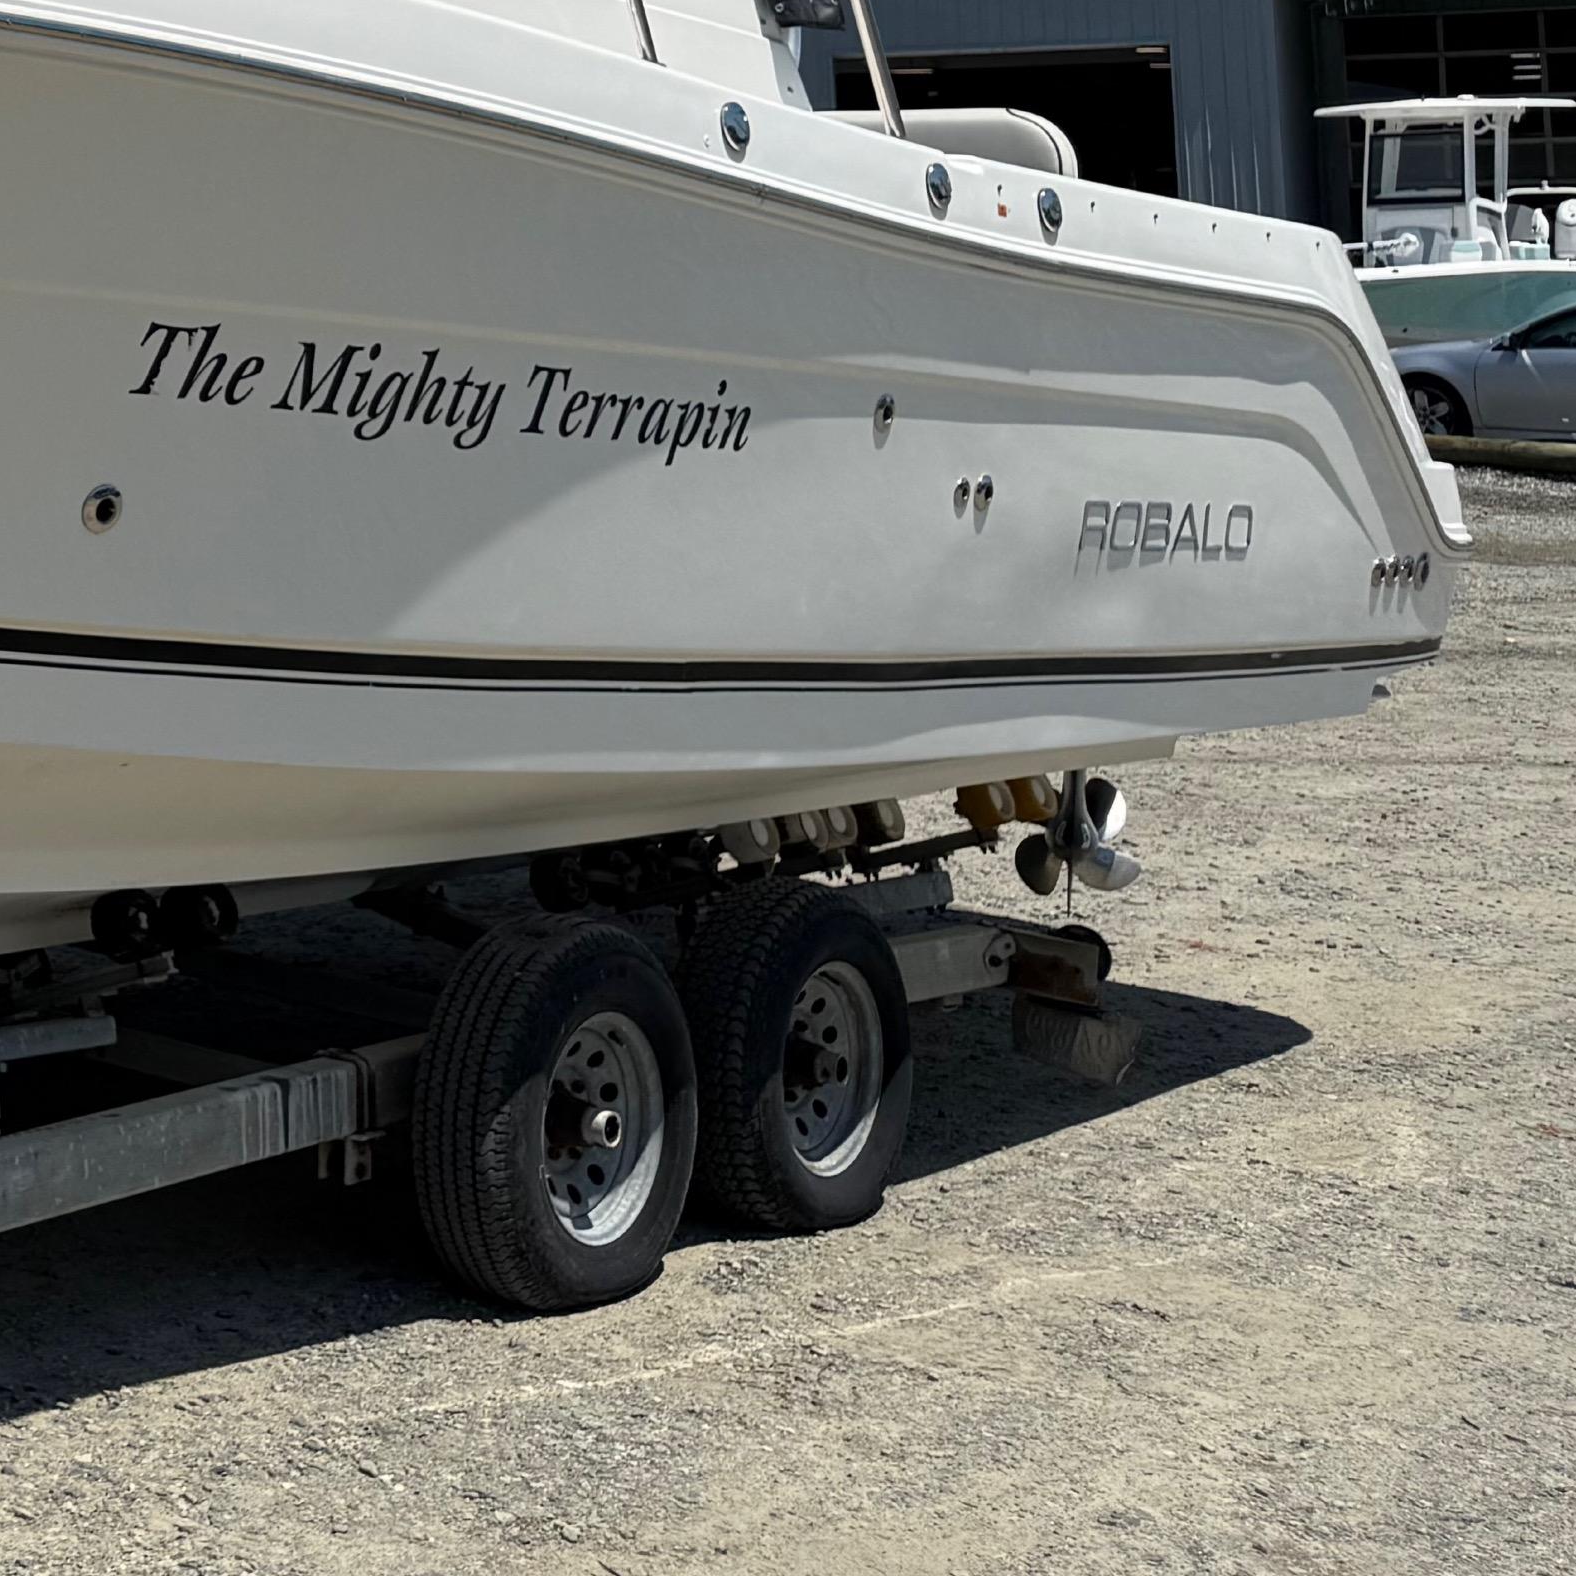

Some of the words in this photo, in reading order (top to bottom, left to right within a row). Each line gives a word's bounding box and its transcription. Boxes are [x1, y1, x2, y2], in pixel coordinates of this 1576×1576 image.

[129, 321, 265, 406] The
[271, 342, 507, 450] Mighty
[519, 364, 753, 466] Terrapin
[1079, 500, 1253, 551] ROBALO
